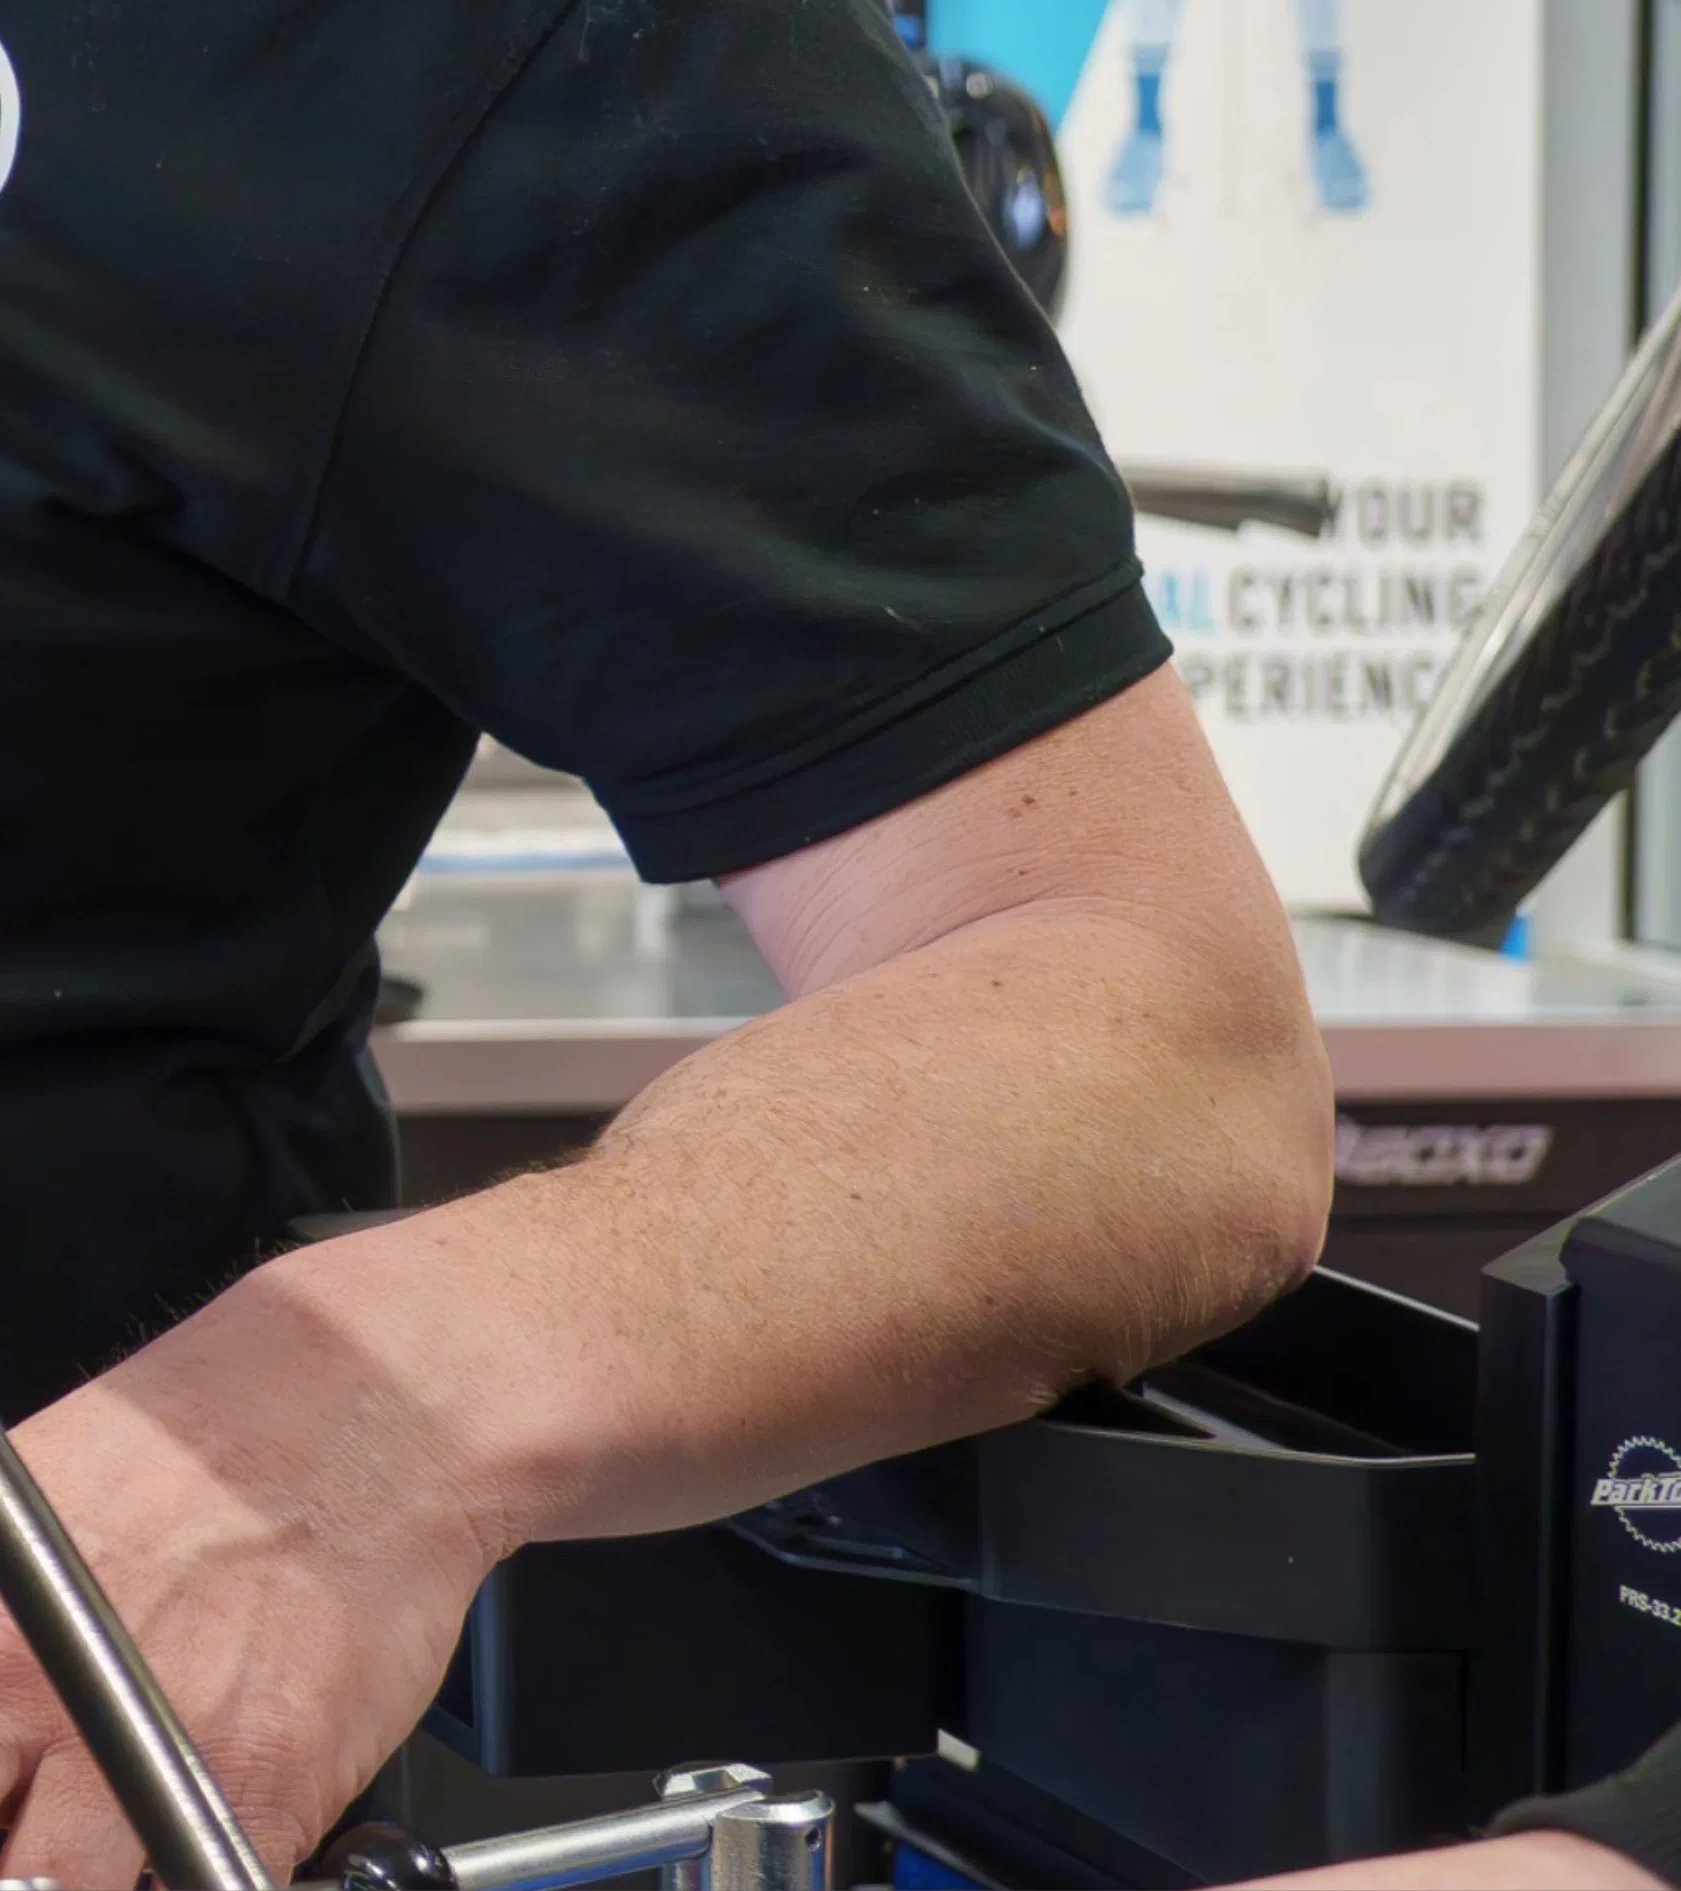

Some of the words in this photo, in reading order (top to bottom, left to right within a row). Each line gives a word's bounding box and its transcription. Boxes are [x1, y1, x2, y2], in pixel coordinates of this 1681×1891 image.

[1158, 566, 1215, 633] AL
[1227, 564, 1484, 632] CYCLING
[1179, 651, 1433, 722] PERIENC
